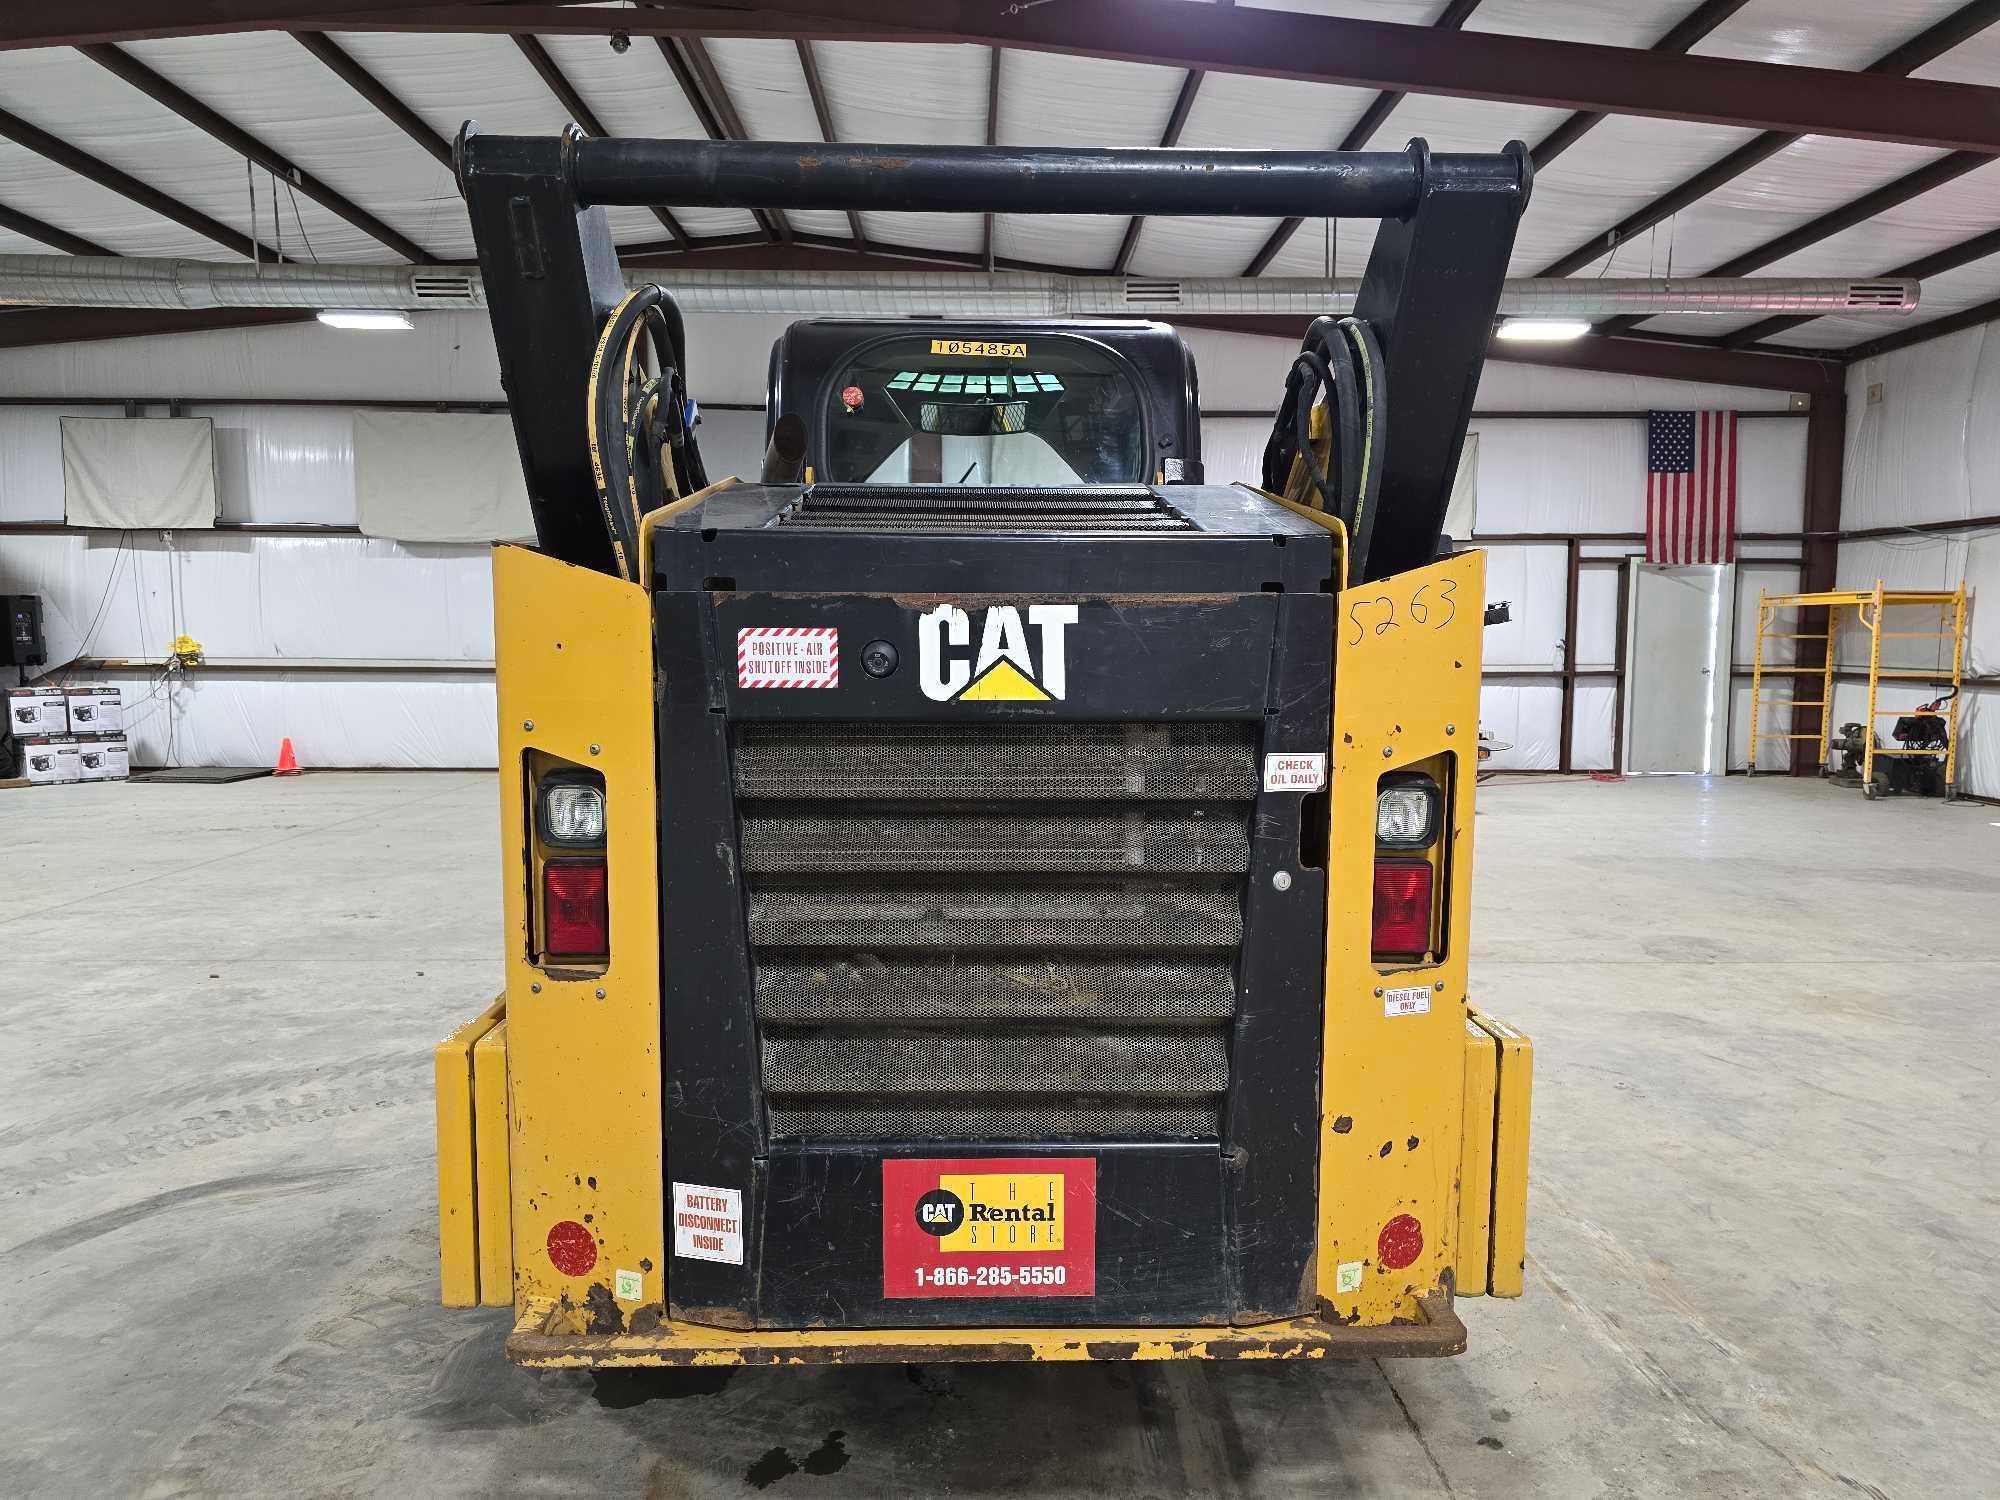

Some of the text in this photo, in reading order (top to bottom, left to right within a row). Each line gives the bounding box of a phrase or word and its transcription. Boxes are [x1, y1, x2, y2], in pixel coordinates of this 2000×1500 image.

[937, 341, 1025, 357] 105485A
[1348, 578, 1458, 646] 5263
[919, 604, 1079, 702] CAT
[748, 660, 828, 676] SHUTOFF INSIDE
[1277, 760, 1313, 771] CHECK
[1270, 773, 1319, 785] OIL DAILY
[1388, 990, 1429, 1003] DIESEL FUEL
[1400, 1001, 1417, 1011] ONLY
[969, 1182, 1055, 1200] THE
[686, 1194, 728, 1213] BATTERY
[922, 1203, 1056, 1223] CAT Rental
[678, 1212, 738, 1234] DISCONNECT
[692, 1234, 724, 1252] INSIDE
[971, 1224, 1055, 1244] STORE
[915, 1265, 1067, 1287] 1-866-285-5550
